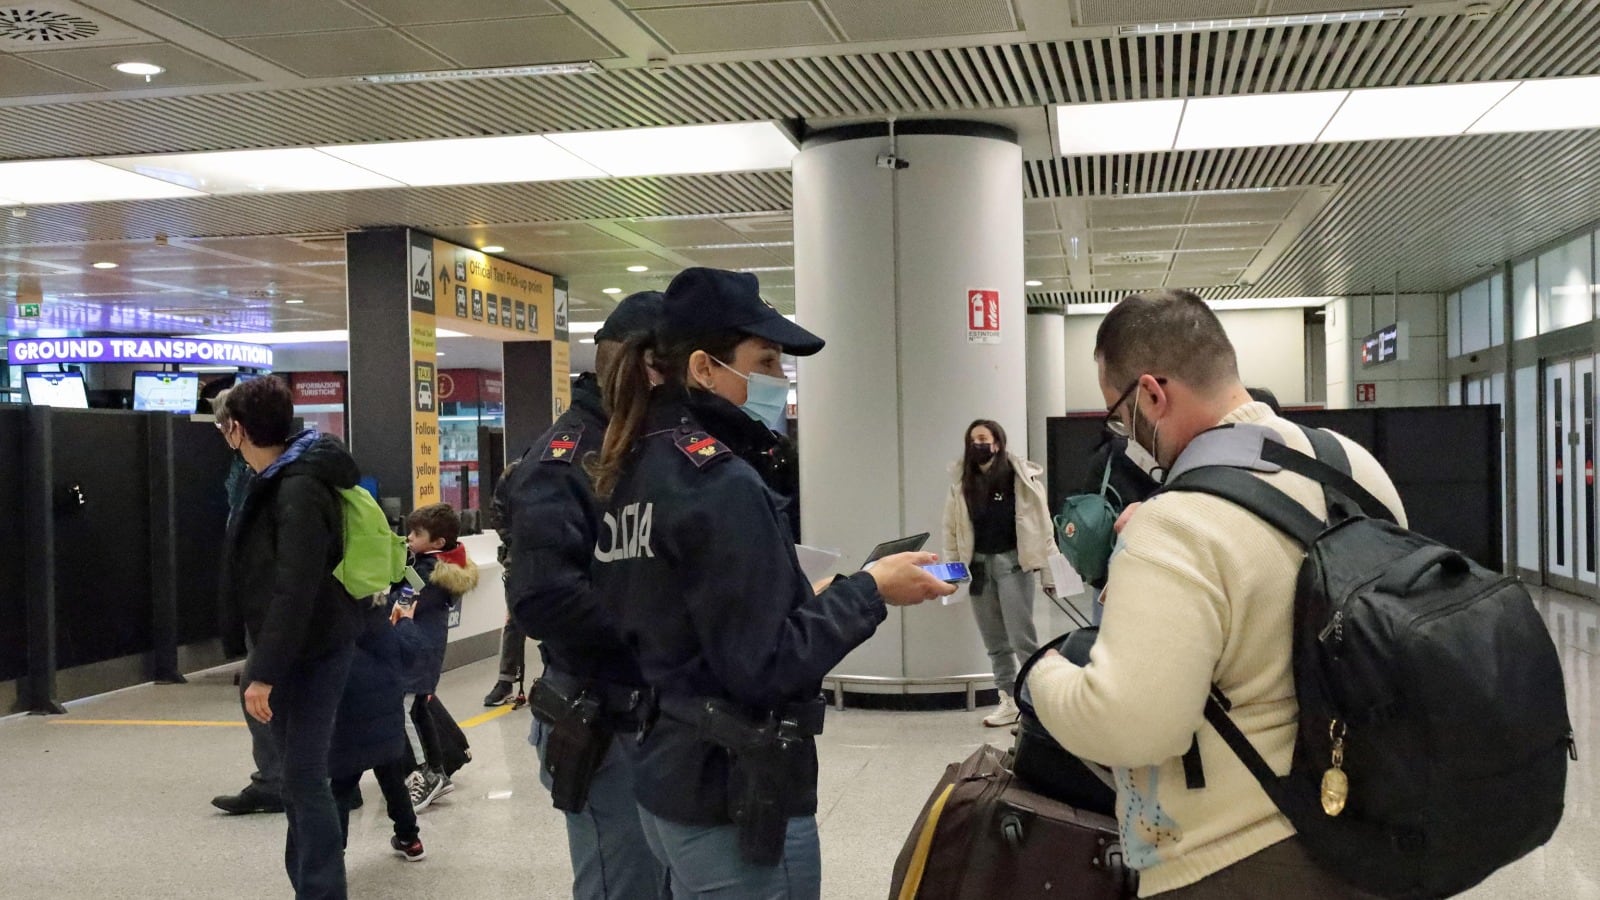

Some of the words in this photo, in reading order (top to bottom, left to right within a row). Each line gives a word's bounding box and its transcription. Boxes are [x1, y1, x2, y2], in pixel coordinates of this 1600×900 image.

[470, 260, 492, 280] Official
[493, 267, 506, 283] Taxi
[507, 271, 527, 294] Pick-up
[414, 279, 431, 297] ADR
[15, 341, 103, 360] GROUND
[110, 340, 267, 365] TRANSPORTATION
[419, 367, 431, 378] TAXI
[415, 422, 436, 435] Follow
[420, 443, 431, 455] the
[416, 463, 437, 479] yellow
[420, 484, 434, 500] path
